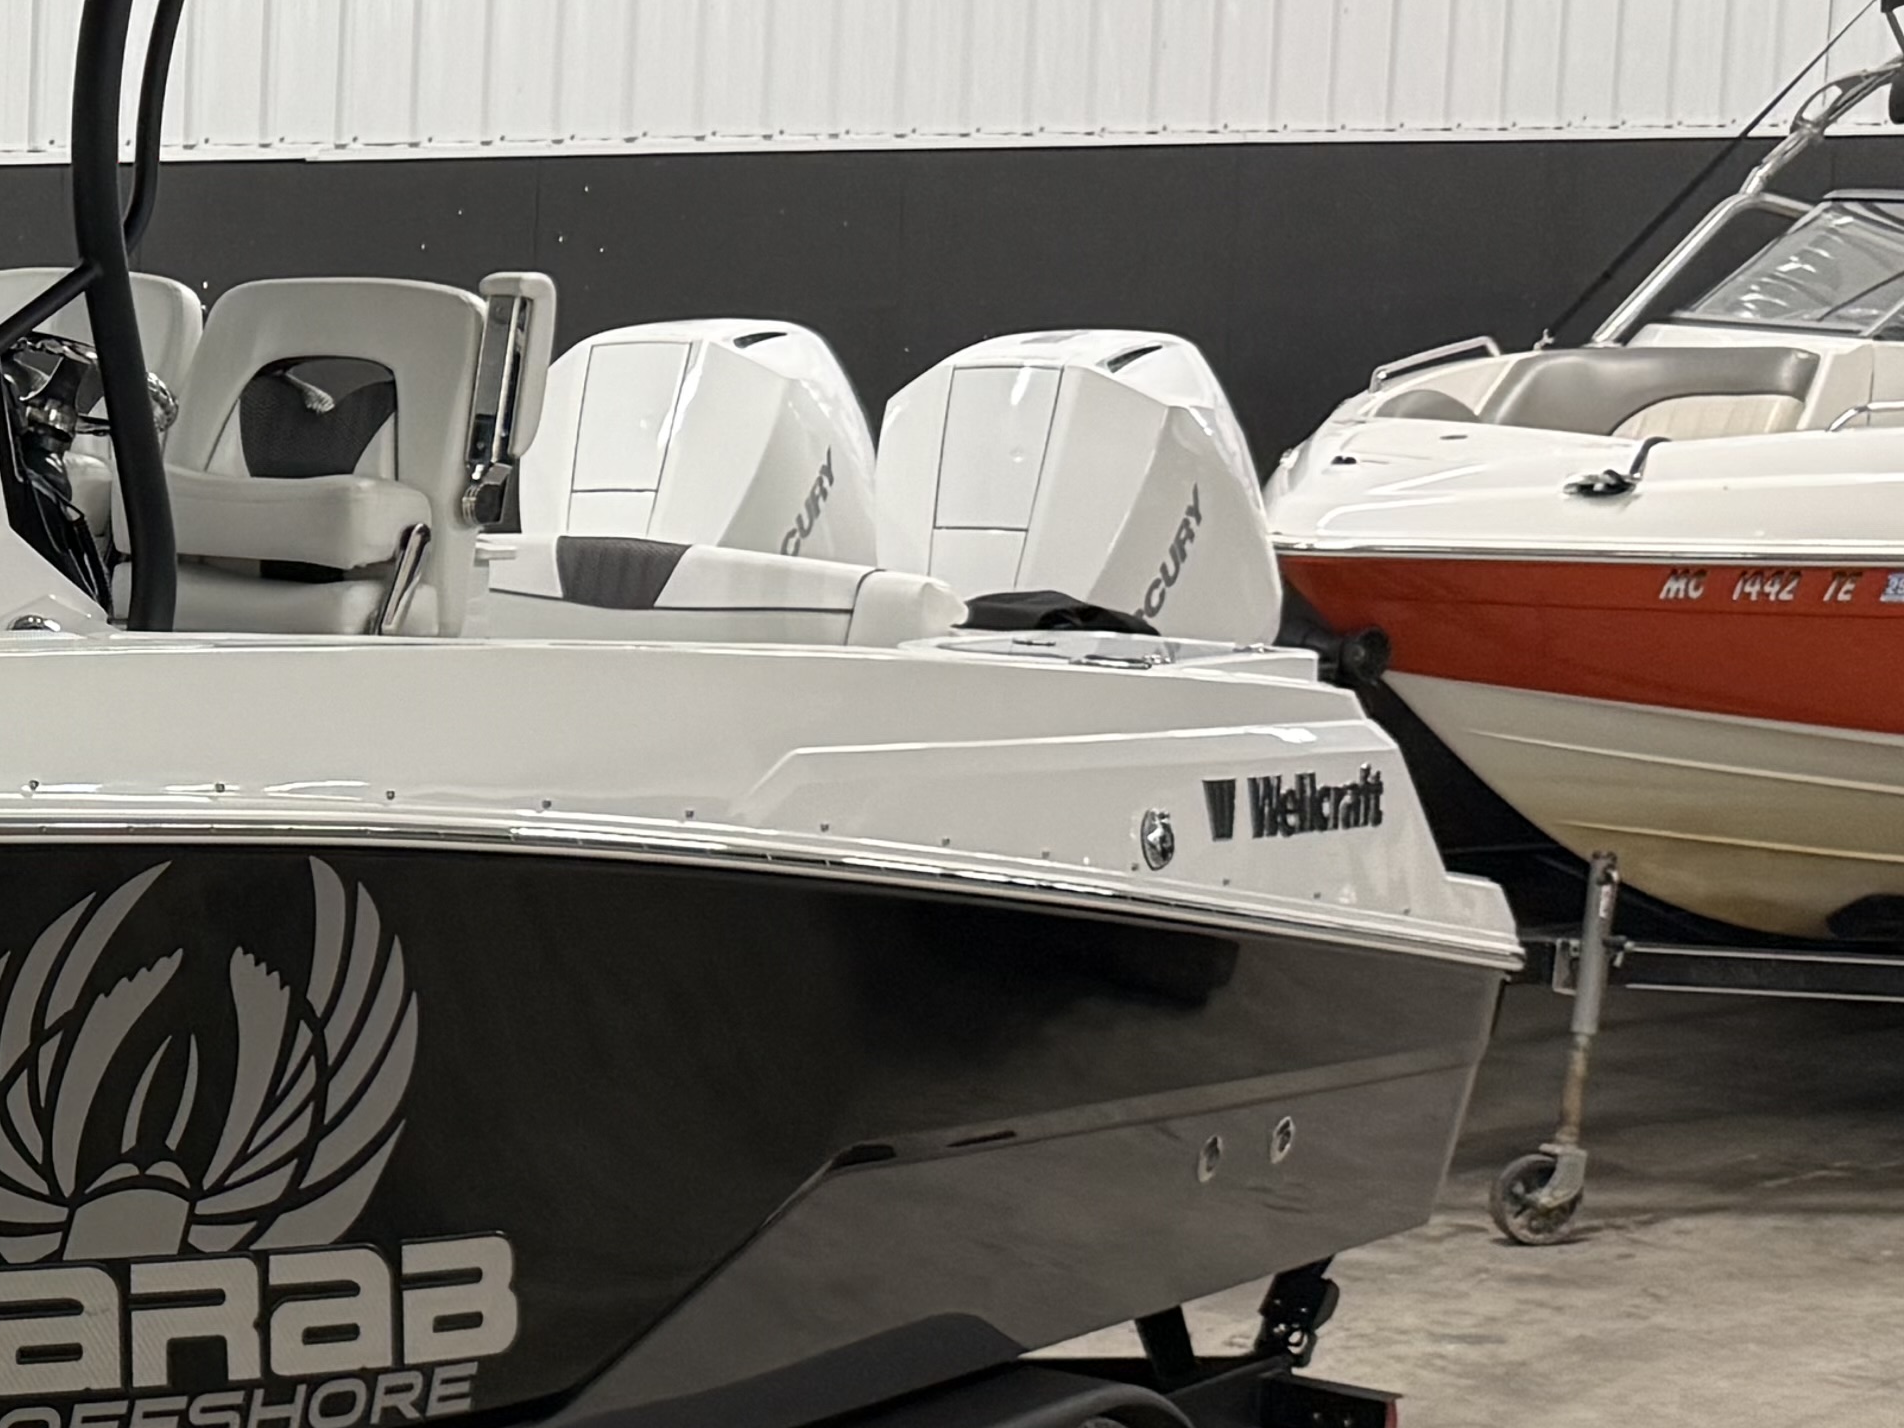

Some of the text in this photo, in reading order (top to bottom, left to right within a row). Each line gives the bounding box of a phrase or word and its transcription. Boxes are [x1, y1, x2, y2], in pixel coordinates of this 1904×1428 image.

[780, 445, 834, 556] CURY
[1134, 482, 1202, 619] CURY
[1659, 569, 1708, 600] MC
[1247, 762, 1384, 838] Wellcraft
